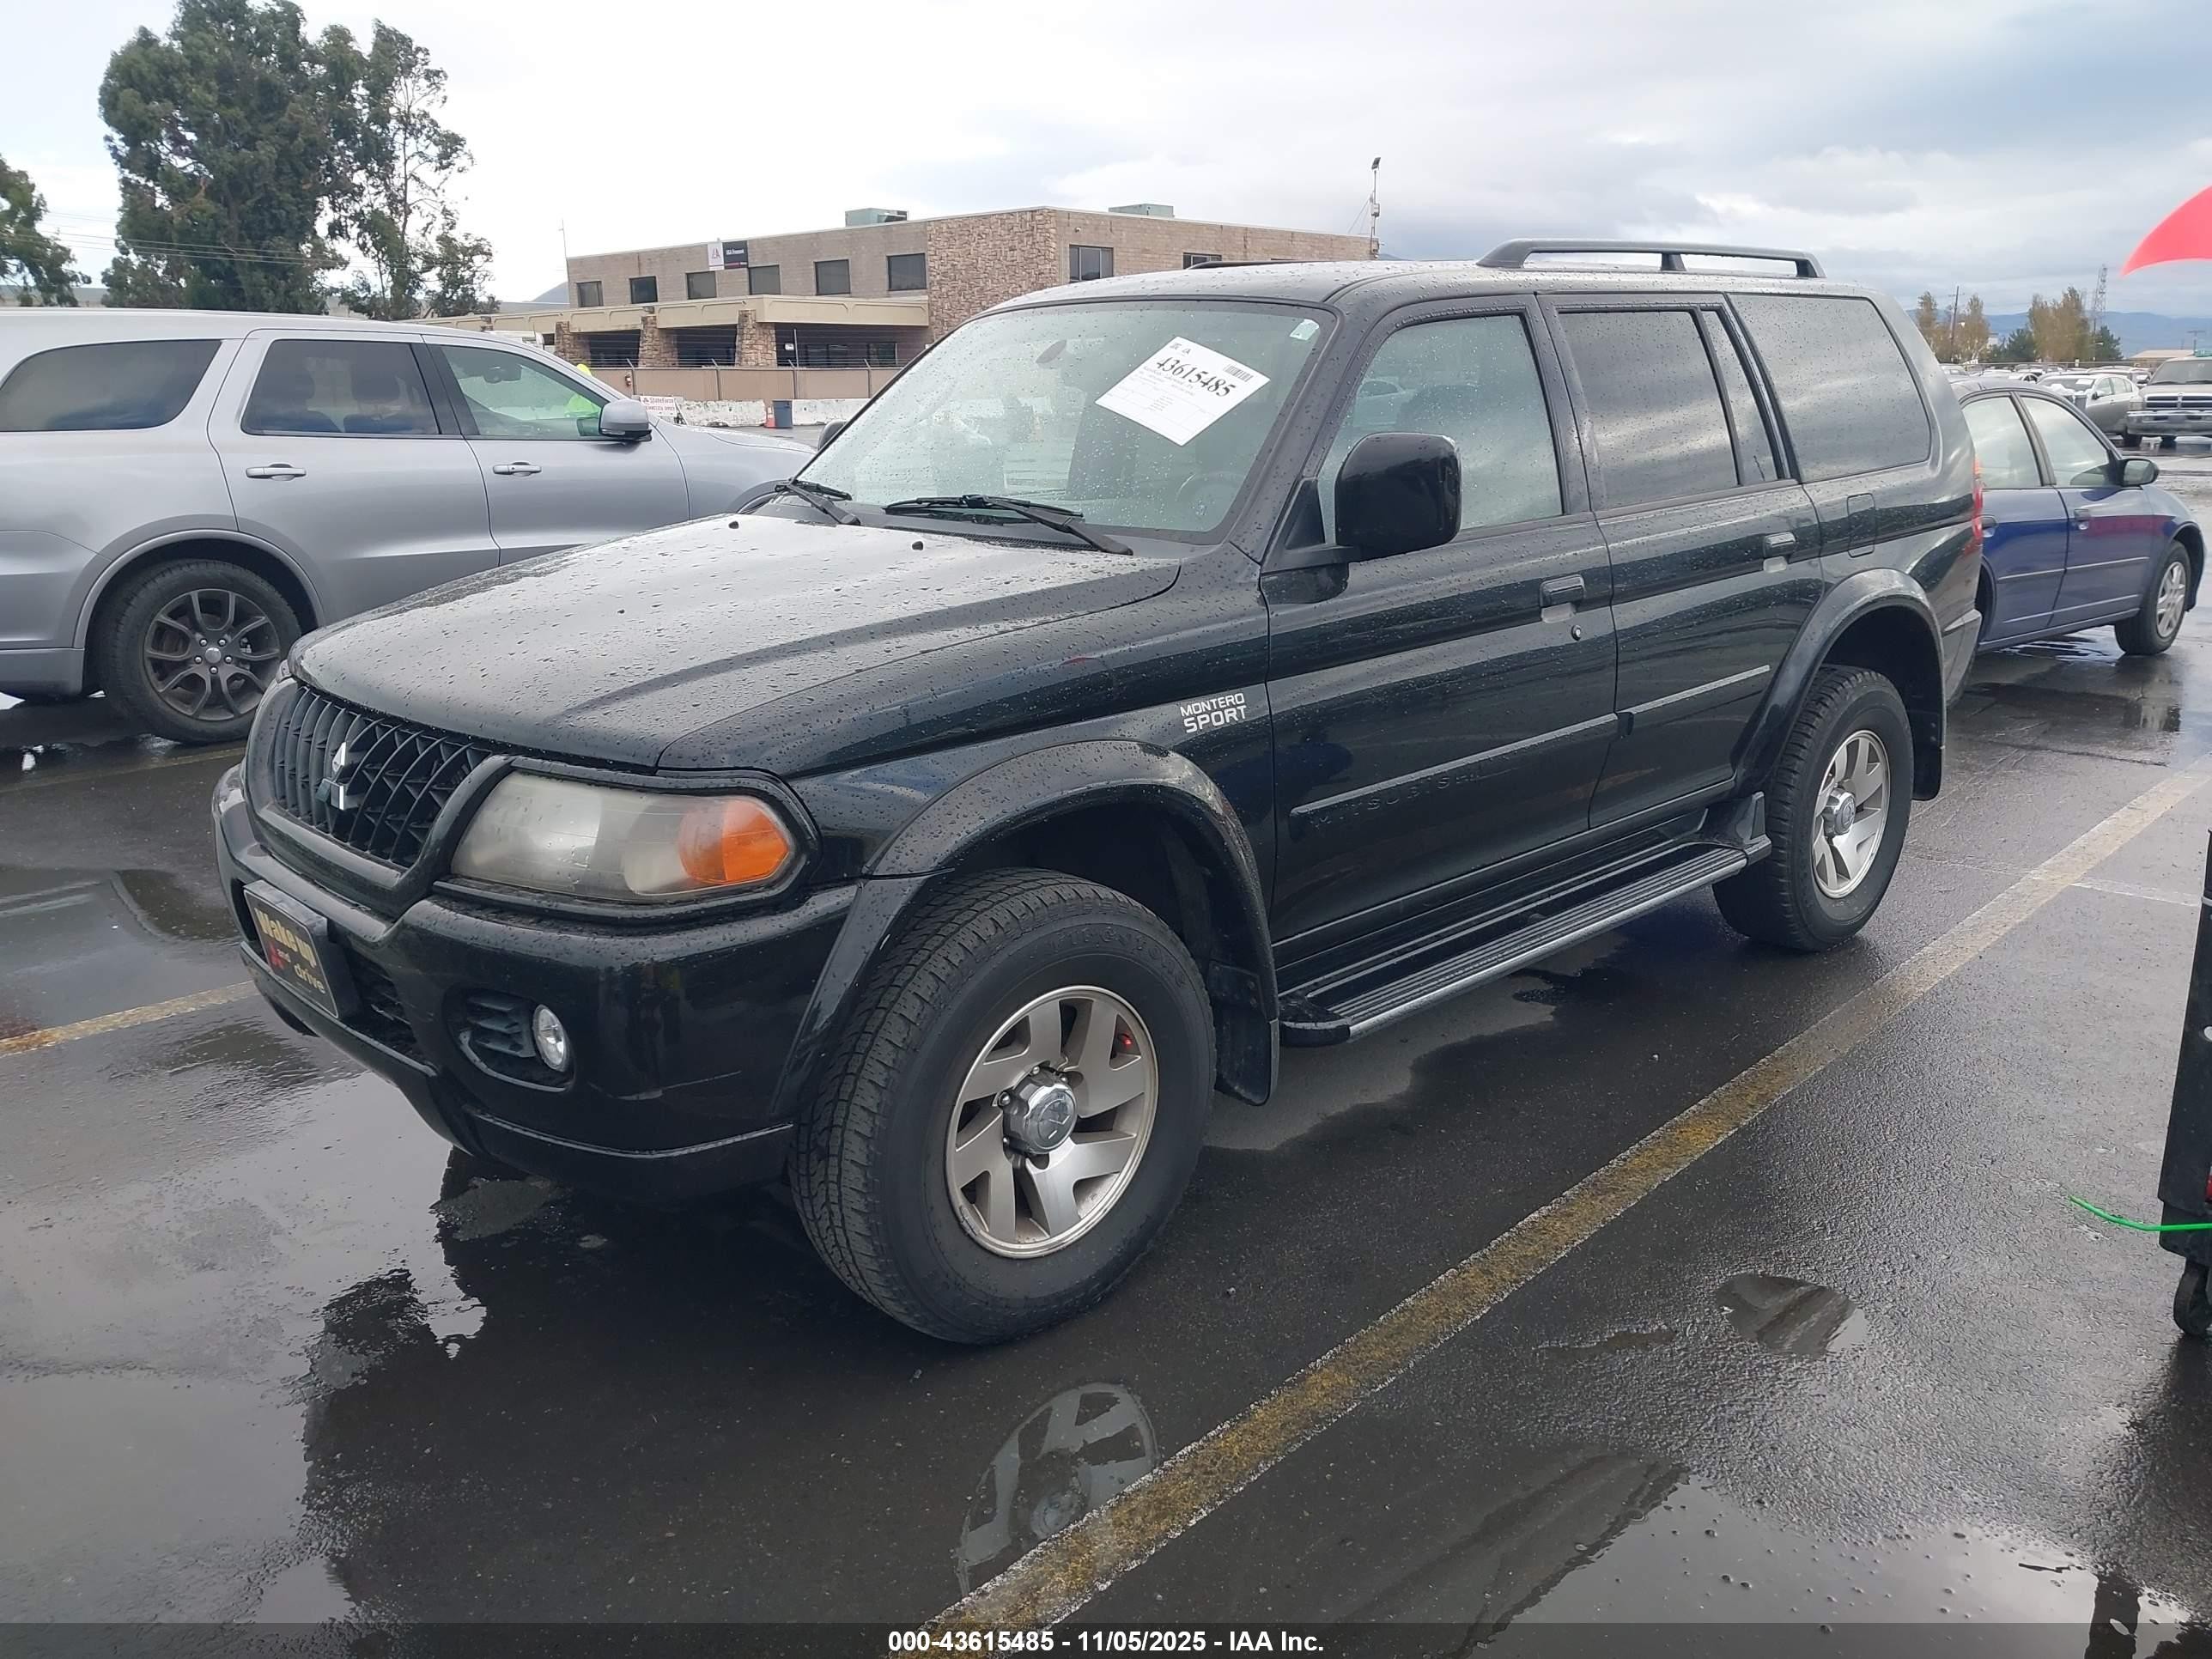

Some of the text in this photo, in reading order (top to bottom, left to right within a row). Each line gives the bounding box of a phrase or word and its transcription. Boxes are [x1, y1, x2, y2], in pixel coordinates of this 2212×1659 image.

[1156, 356, 1237, 397] 43615485
[1181, 693, 1245, 716] MONTERO
[1184, 706, 1247, 732] SPORT
[294, 963, 326, 994] drive
